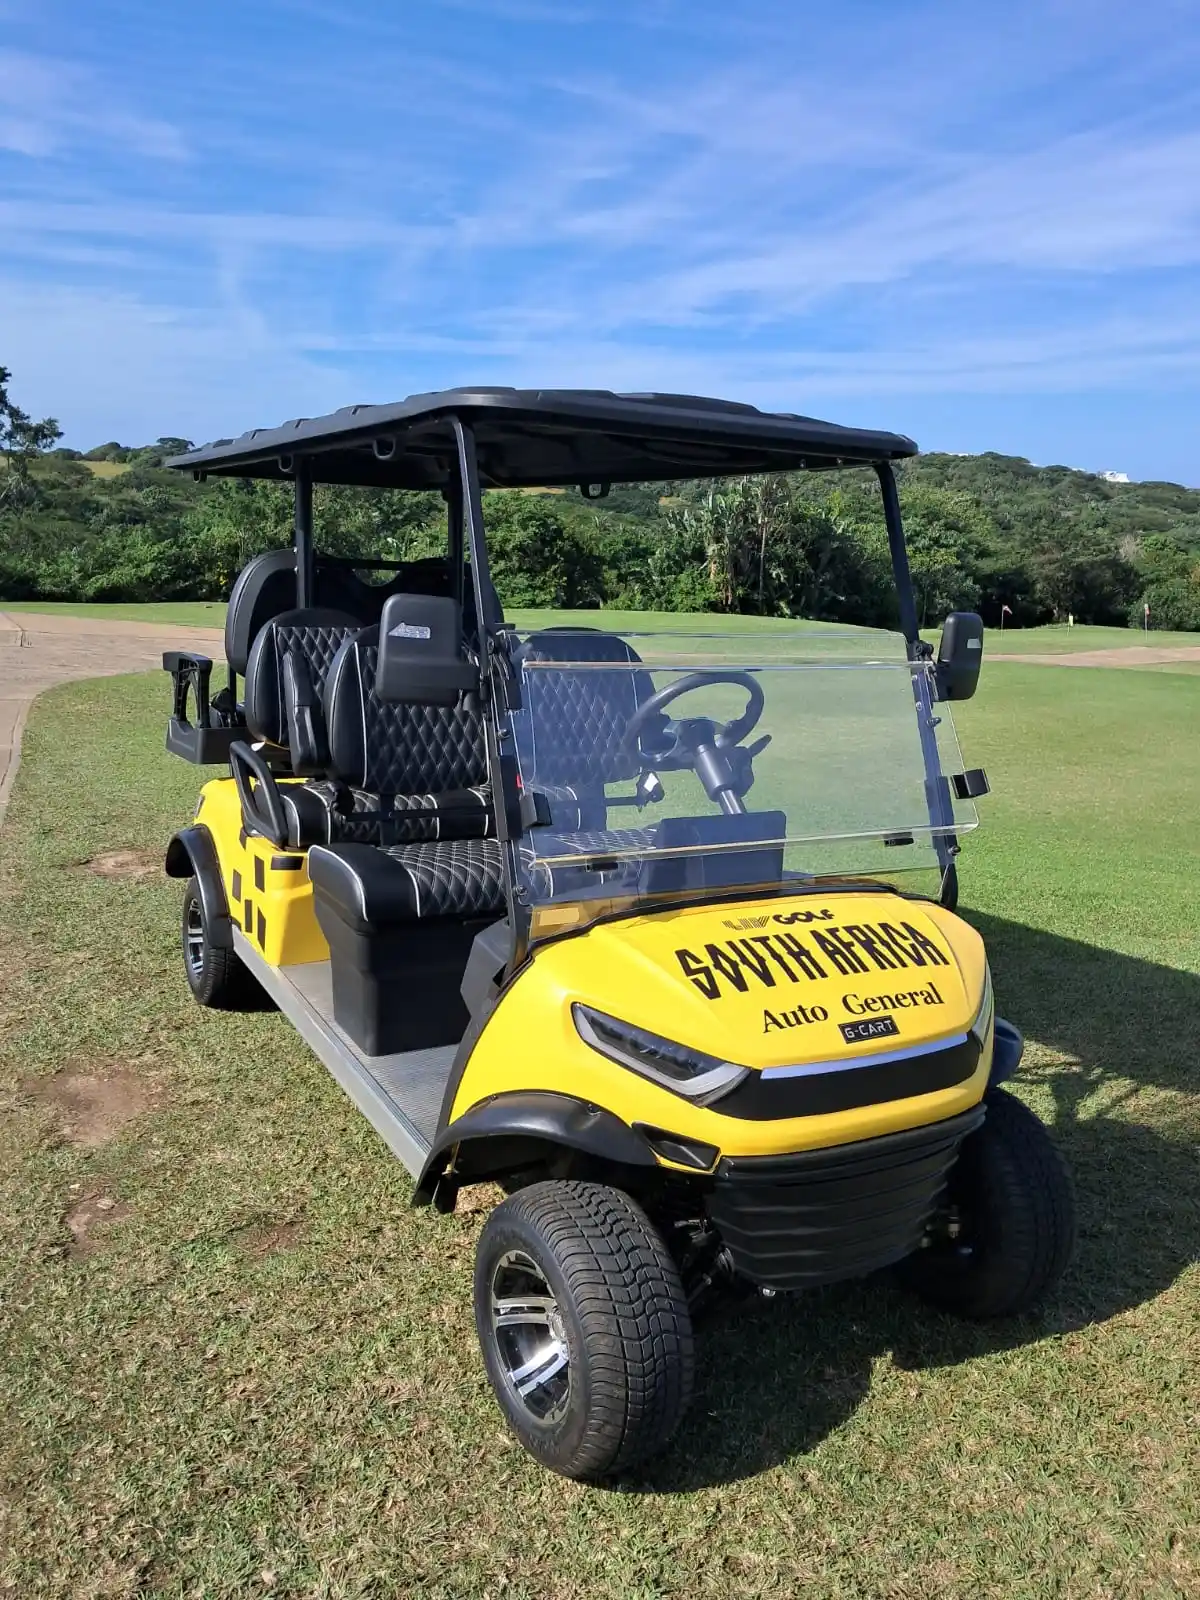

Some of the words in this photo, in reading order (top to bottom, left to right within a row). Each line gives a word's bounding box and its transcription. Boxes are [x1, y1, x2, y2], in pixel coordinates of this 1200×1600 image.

[722, 916, 770, 930] LIV
[675, 933, 828, 1000] SOUTH
[809, 922, 950, 976] AFRICA
[763, 1004, 829, 1033] Auto
[842, 982, 944, 1015] General
[844, 1020, 894, 1038] G-CART
